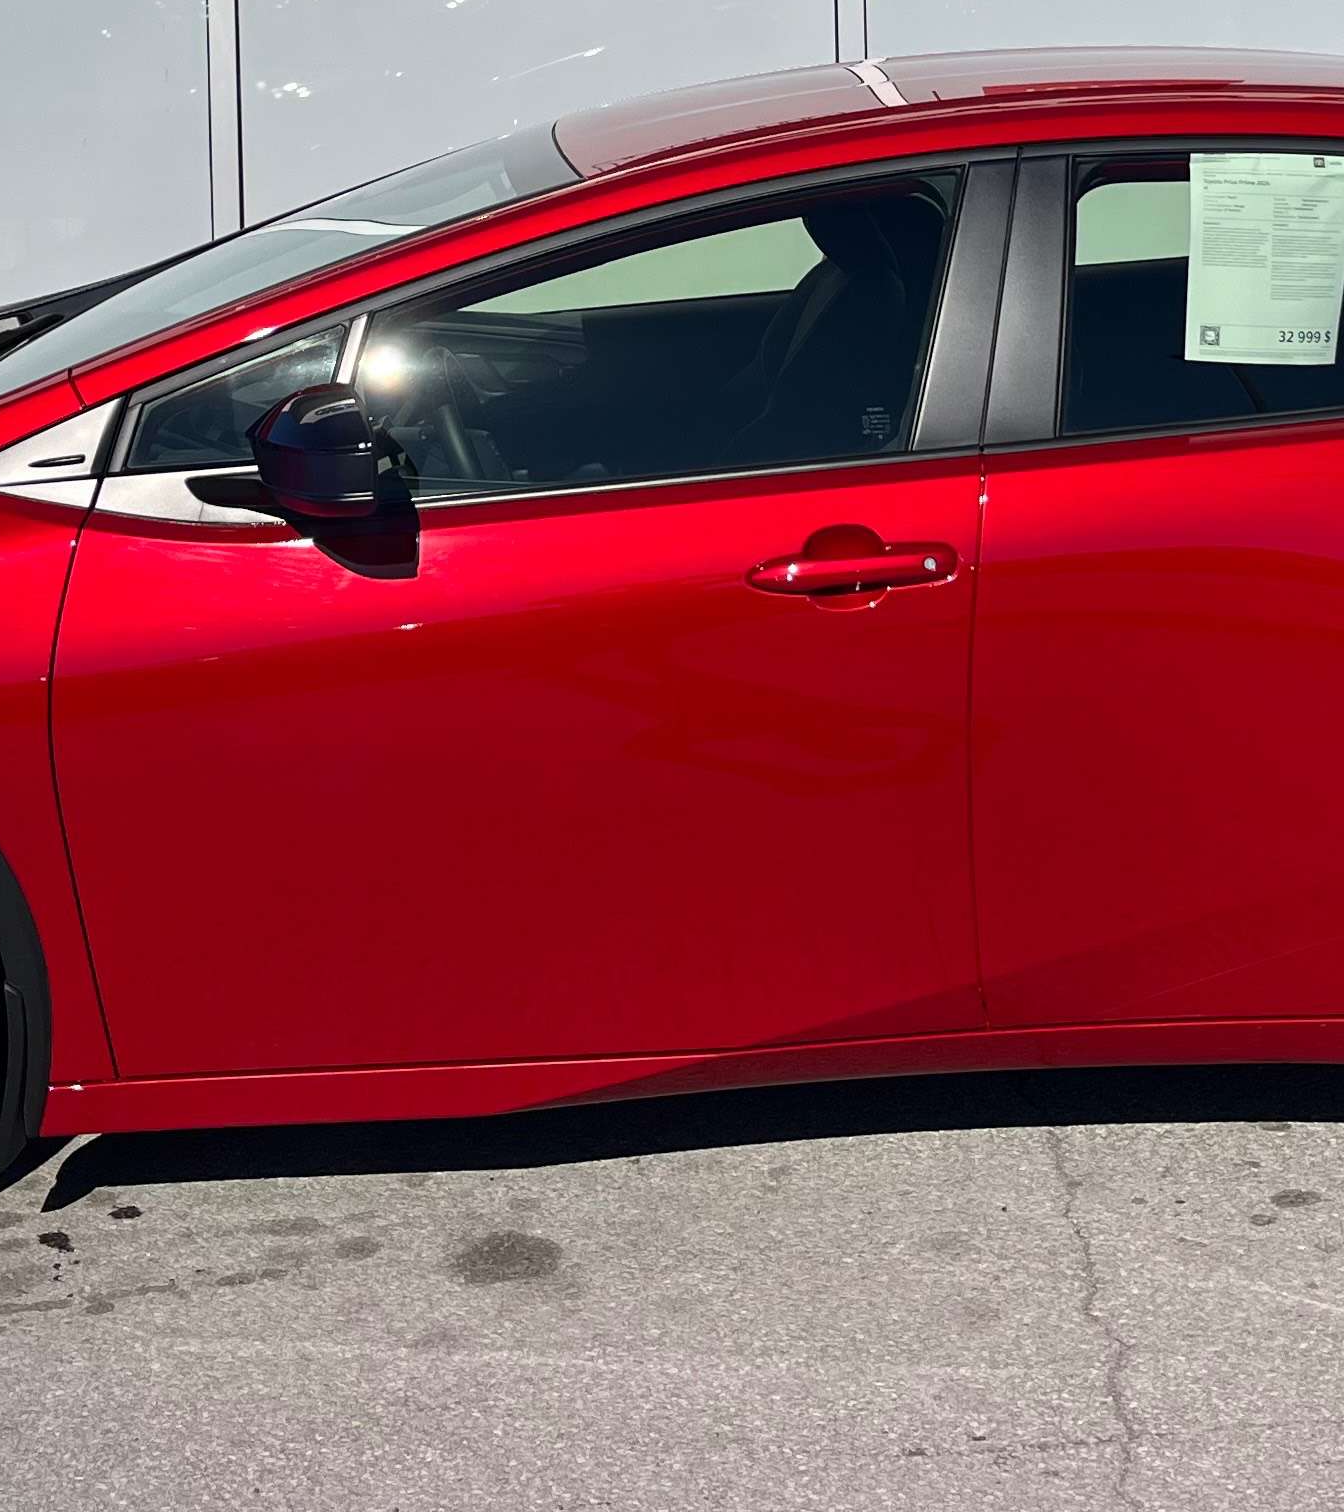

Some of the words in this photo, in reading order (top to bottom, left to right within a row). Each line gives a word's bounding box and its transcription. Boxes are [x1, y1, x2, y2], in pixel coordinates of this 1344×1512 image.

[1278, 330, 1294, 343] 32
[1297, 330, 1321, 344] 999
[1324, 330, 1332, 344] $
